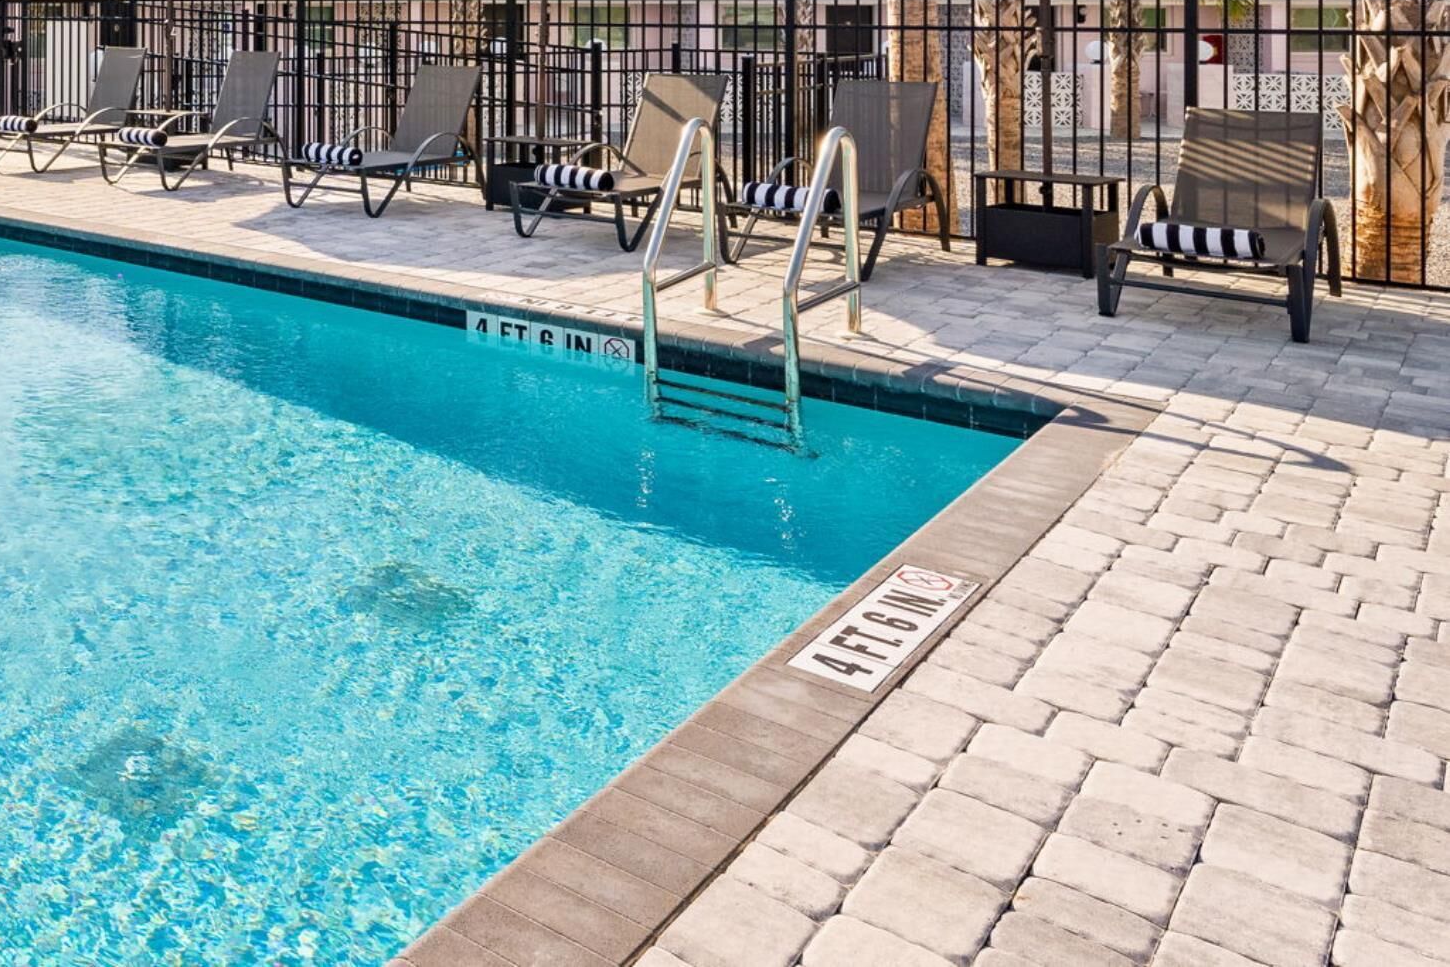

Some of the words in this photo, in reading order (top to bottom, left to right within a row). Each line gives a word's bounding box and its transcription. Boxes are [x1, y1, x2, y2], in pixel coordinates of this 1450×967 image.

[475, 317, 488, 334] 4
[500, 322, 528, 341] FT
[539, 329, 554, 346] 6
[565, 333, 592, 354] IN
[811, 652, 874, 677] 4
[861, 610, 919, 633] 6
